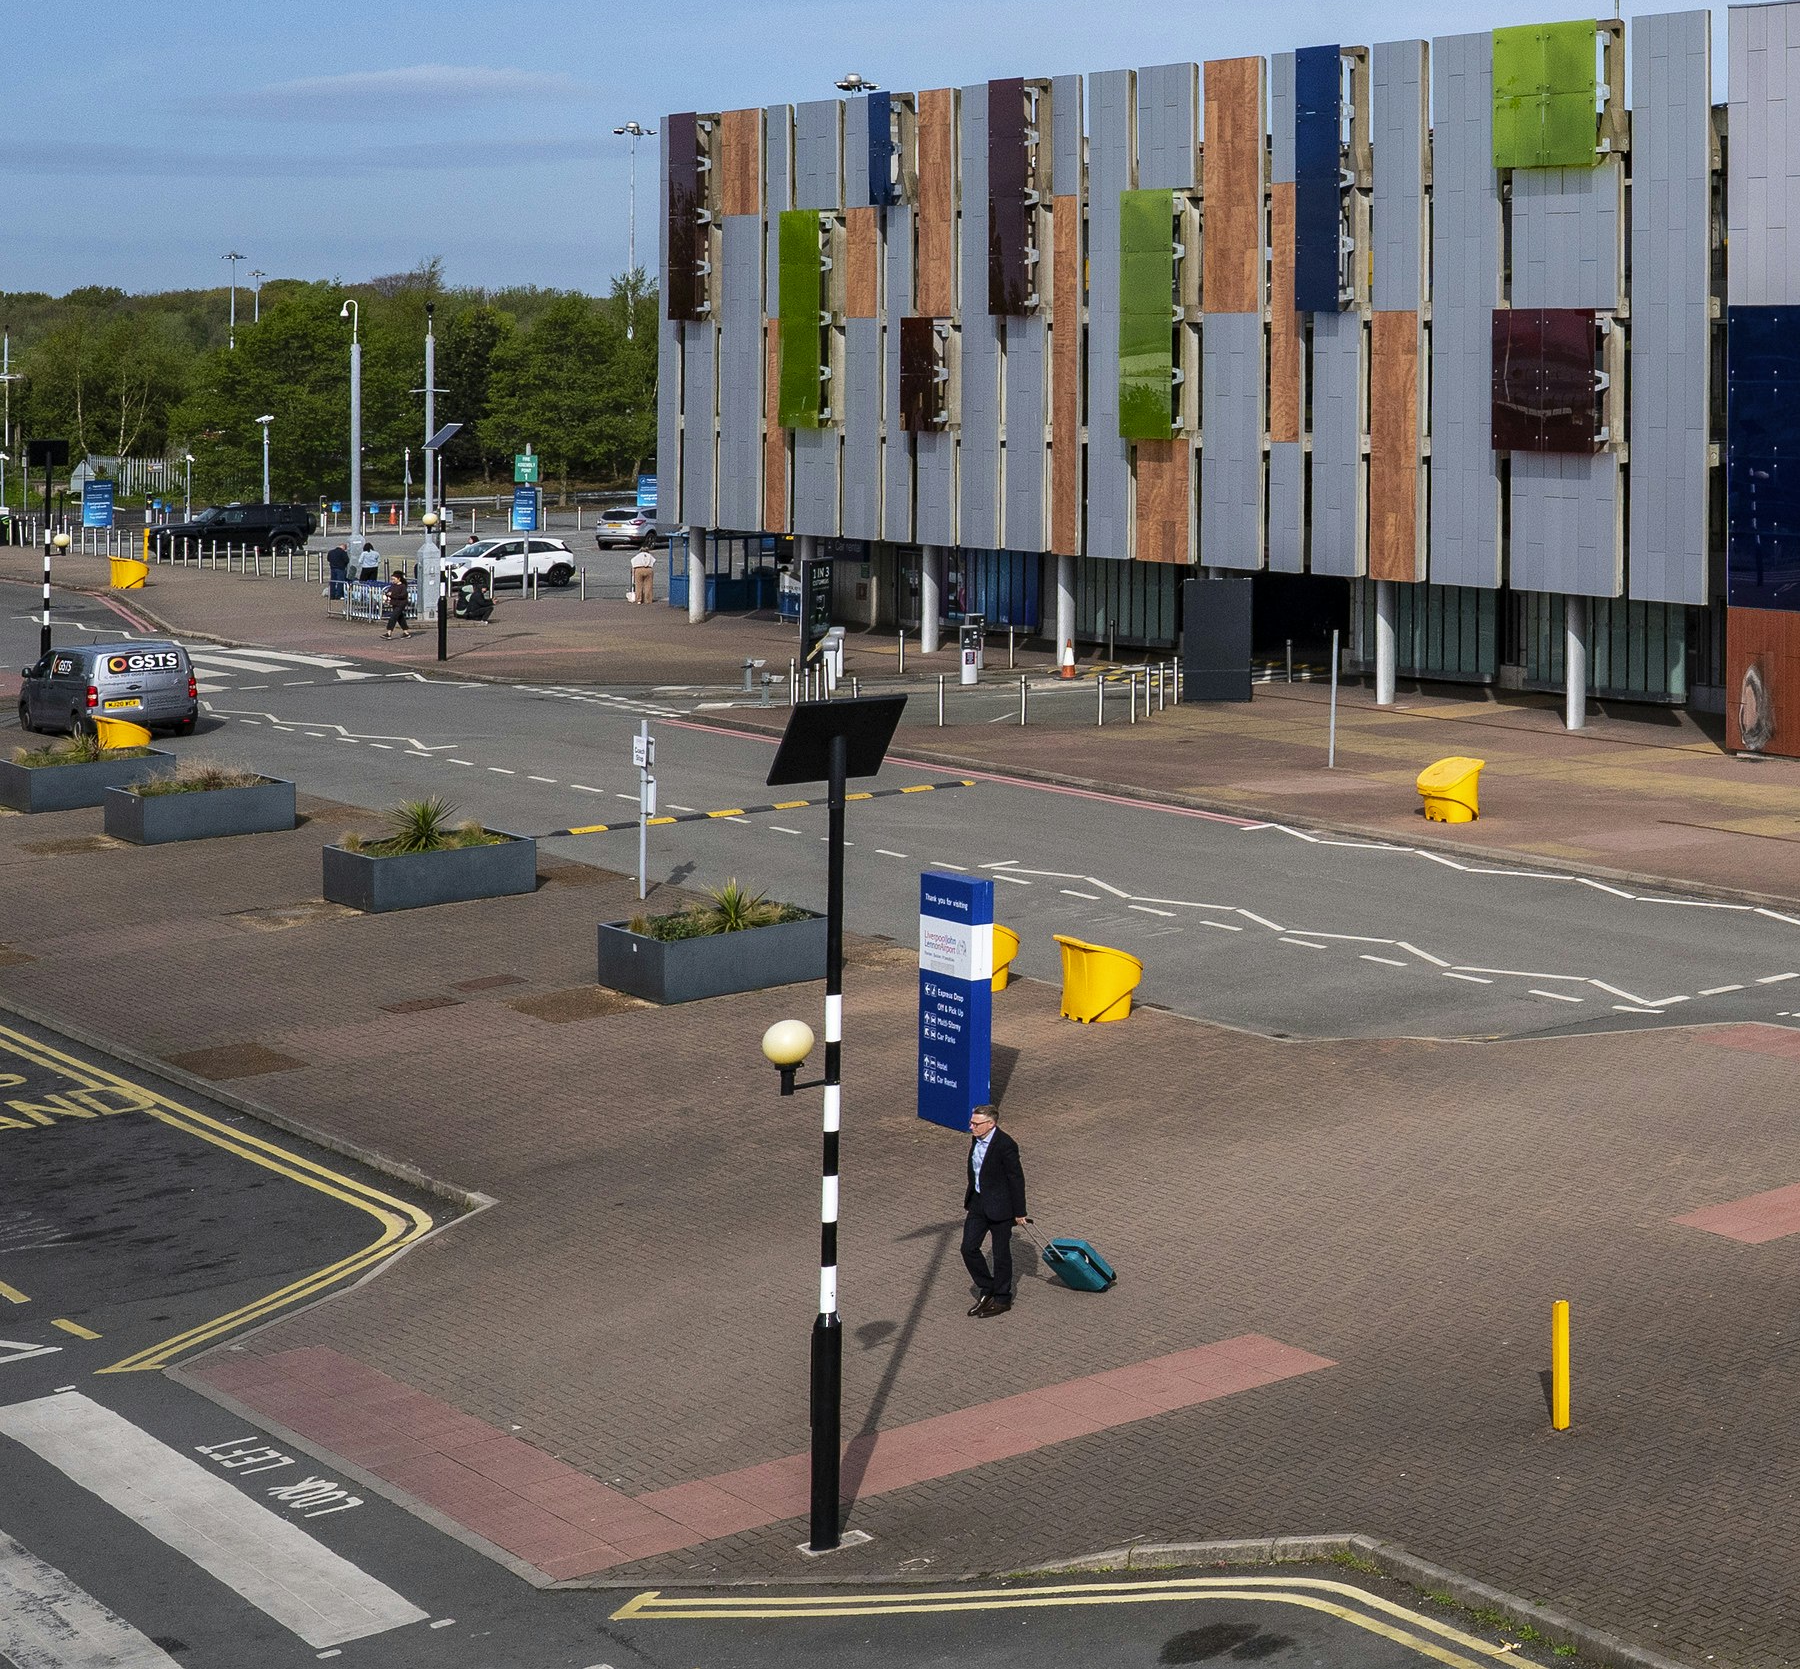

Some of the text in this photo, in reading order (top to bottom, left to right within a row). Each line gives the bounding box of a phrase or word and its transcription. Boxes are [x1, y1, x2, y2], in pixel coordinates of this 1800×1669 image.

[817, 567, 825, 578] IN
[825, 566, 830, 578] 3
[58, 659, 73, 672] GSTS
[128, 653, 177, 668] GSTS
[925, 893, 937, 903] Thank
[938, 897, 946, 905] you
[953, 900, 968, 911] visiting
[938, 988, 964, 1003] Express Drop
[948, 1006, 957, 1015] Pick
[957, 1008, 964, 1017] Up
[937, 1017, 961, 1032] Multi-Storey
[944, 1034, 956, 1044] Parks
[937, 1061, 948, 1071] Hotel
[944, 1077, 958, 1088] Rental
[194, 1436, 364, 1518] LOOK LEFT
